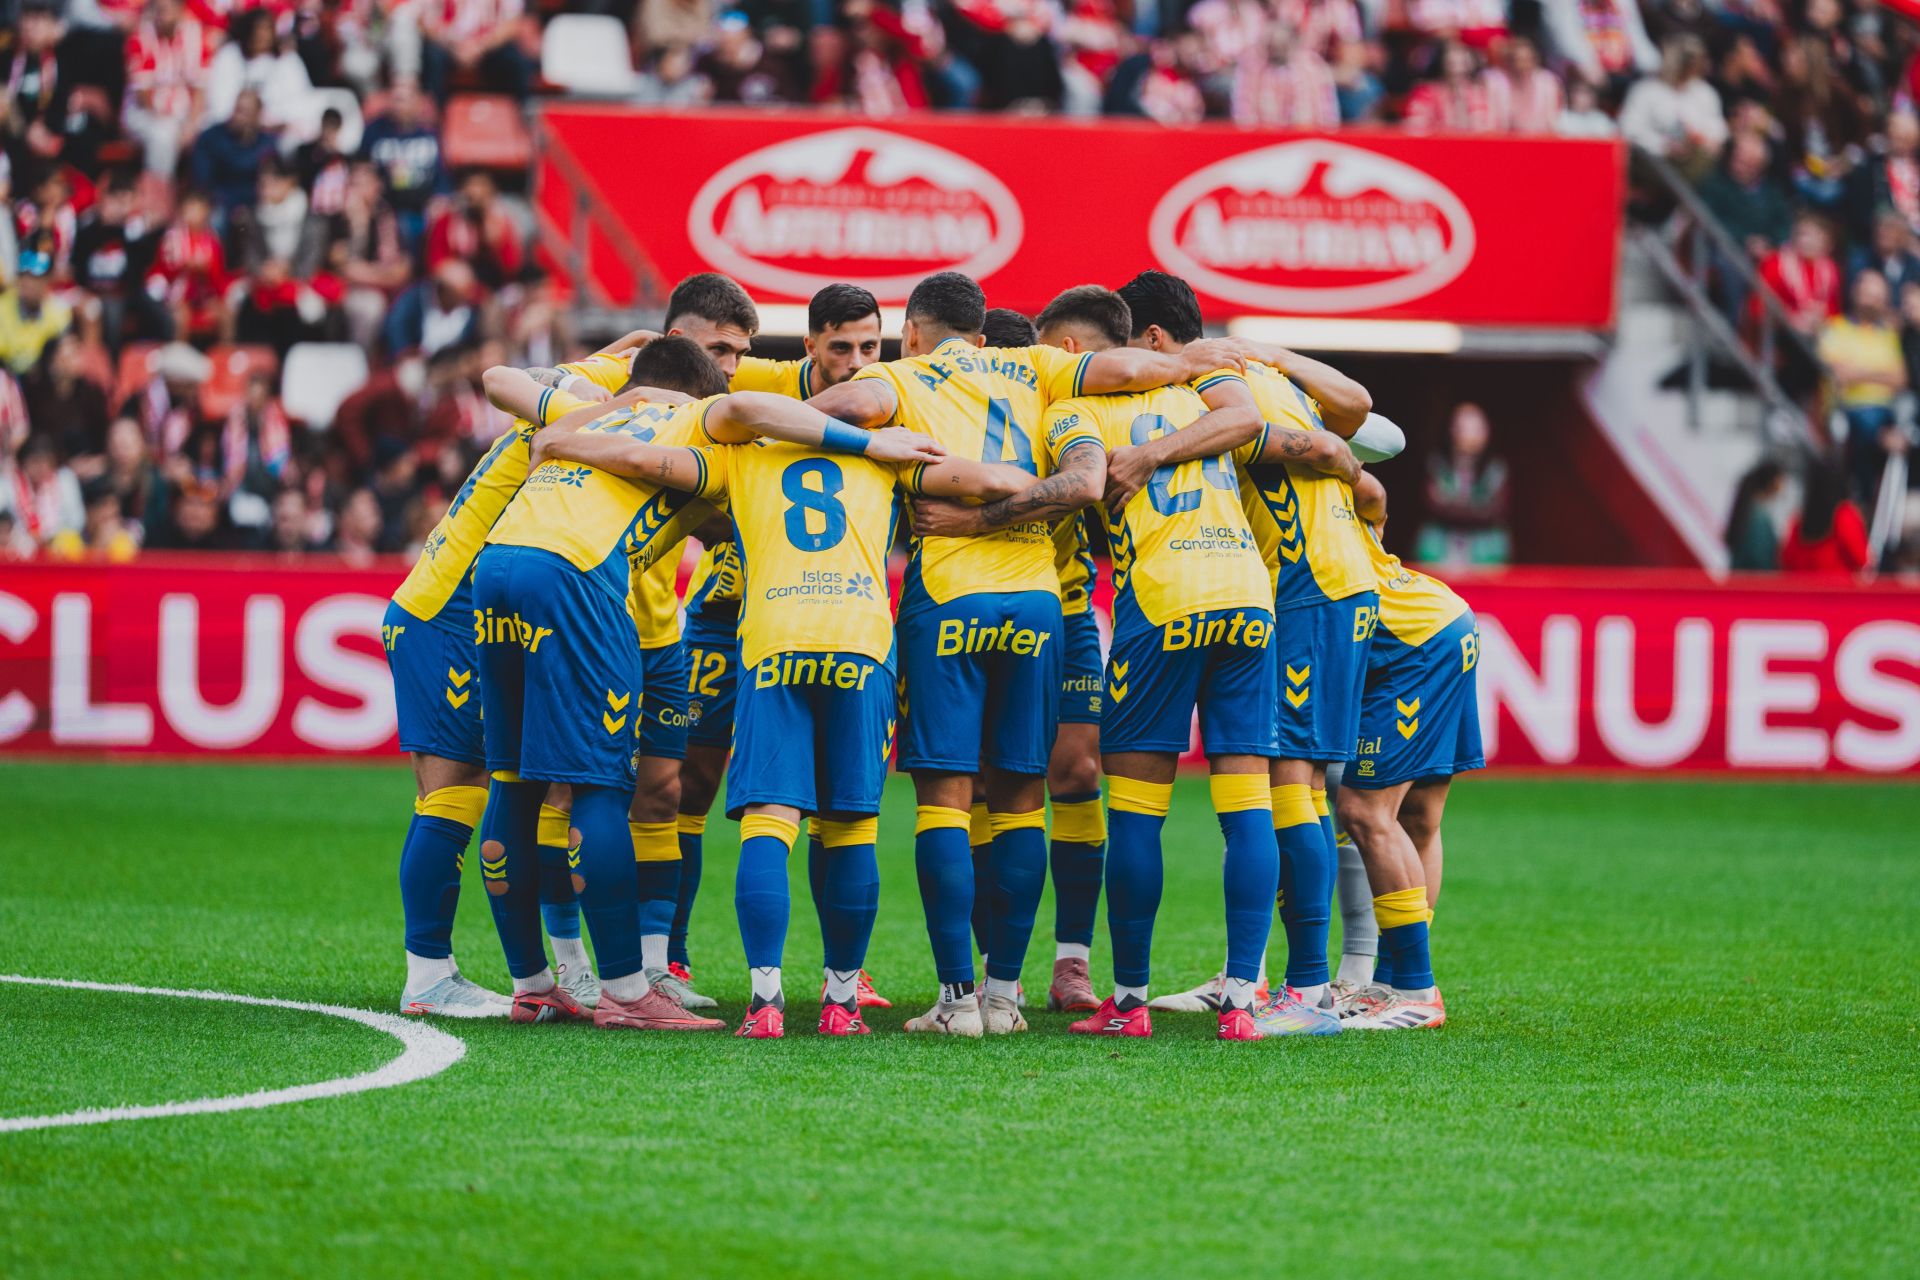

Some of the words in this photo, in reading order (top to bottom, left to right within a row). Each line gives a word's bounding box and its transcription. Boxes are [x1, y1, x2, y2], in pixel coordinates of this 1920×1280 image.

[982, 395, 1038, 477] 4
[782, 457, 847, 552] 8
[1200, 525, 1236, 538] Islas
[802, 571, 842, 583] Islas
[936, 617, 1051, 657] Binter
[1163, 611, 1273, 652] Binter
[688, 649, 727, 697] 12
[755, 652, 875, 691] Binter
[1063, 675, 1104, 692] rdial
